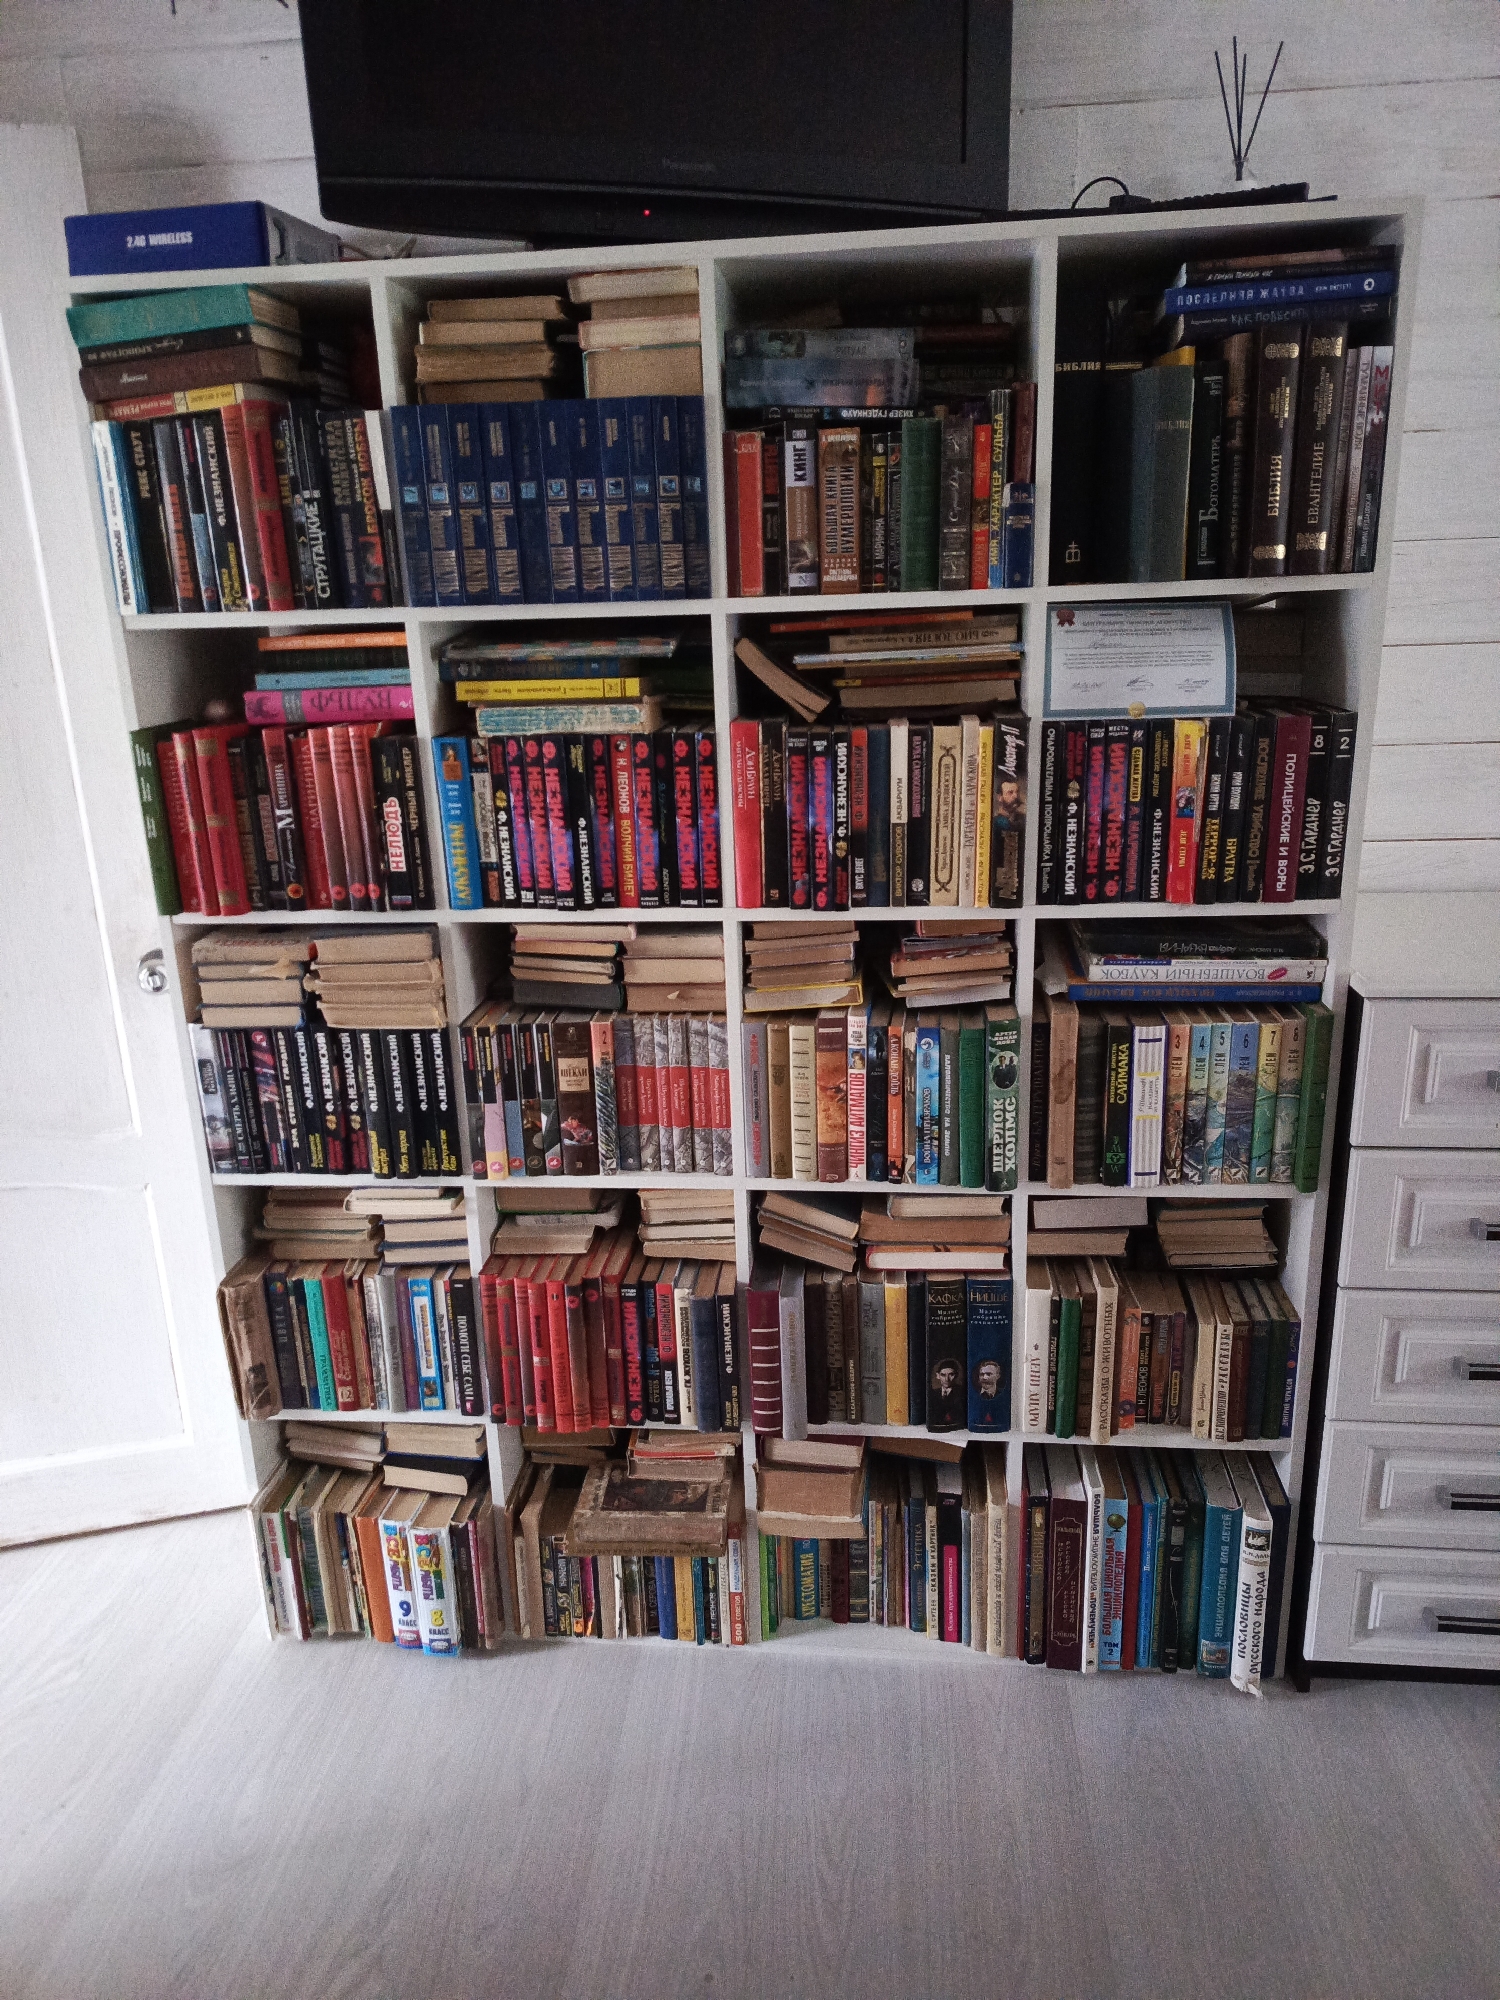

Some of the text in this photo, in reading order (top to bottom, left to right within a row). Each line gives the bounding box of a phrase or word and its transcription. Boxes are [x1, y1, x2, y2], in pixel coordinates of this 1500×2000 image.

[792, 444, 808, 483] КИНГ
[1265, 453, 1283, 517] БИБЛИЯ
[1306, 440, 1326, 525] ЕВАНГЕЛИЕ
[304, 501, 331, 599] СТРУГАЦКИЕ
[834, 742, 849, 822] НЕЗНАНСКИЙ
[895, 777, 904, 822] АКВАРИУМ
[1277, 752, 1298, 844] ПОЛИЦЕЙСКИЕ
[382, 796, 408, 873] НЕЛЮДЬ
[499, 825, 517, 901] НЕЗНАНСКИЙ
[1064, 817, 1078, 896] НЕЗНАНСКИЙ
[1222, 837, 1238, 883] БРАТВА
[1275, 858, 1290, 892] ВОРЫ
[1101, 966, 1268, 981] ВОЛШЕБНЫЙ КЛУБОК
[315, 1032, 333, 1100] НЕЗНАНСКИЙ
[339, 1032, 357, 1100] НЕЗНАНСКИЙ
[1117, 1042, 1130, 1105] САЙМАКА
[847, 1073, 865, 1170] ЧИНГИЗ АЙТМАТОВ
[921, 1088, 932, 1165] ВОЙНА ПРИЗРАКОВ
[990, 1098, 1005, 1175] ШЕРЛОК
[1003, 1095, 1017, 1172] ХОЛМС
[455, 1314, 472, 1376] ПОМОГИ СЕБЕ
[1100, 1302, 1114, 1364] ЖИВОТНЫХ
[1098, 1375, 1111, 1431] РАССКАЗЫ
[1136, 1366, 1149, 1397] ЛЕОНОВ
[1092, 1492, 1102, 1536] БОЛЬШАЯ
[398, 1599, 412, 1617] 9
[799, 1552, 817, 1618] ХРЕСТОМАТИЯ
[1100, 1537, 1115, 1637] БОЛЬШАЯ ШКОЛЬНАЯ
[1110, 1550, 1125, 1621] ЭНЦИКЛОПЕДИЯ
[1213, 1513, 1233, 1639] ЭНЦИКЛОПЕДИЯ ДЛЯ ДЕТЕЙ
[428, 1626, 450, 1636] КЛАСС
[430, 1608, 444, 1627] 8
[735, 1623, 743, 1643] 500
[1236, 1580, 1252, 1659] ПОСЛОВИЦЫ
[1249, 1570, 1267, 1675] русского народа
